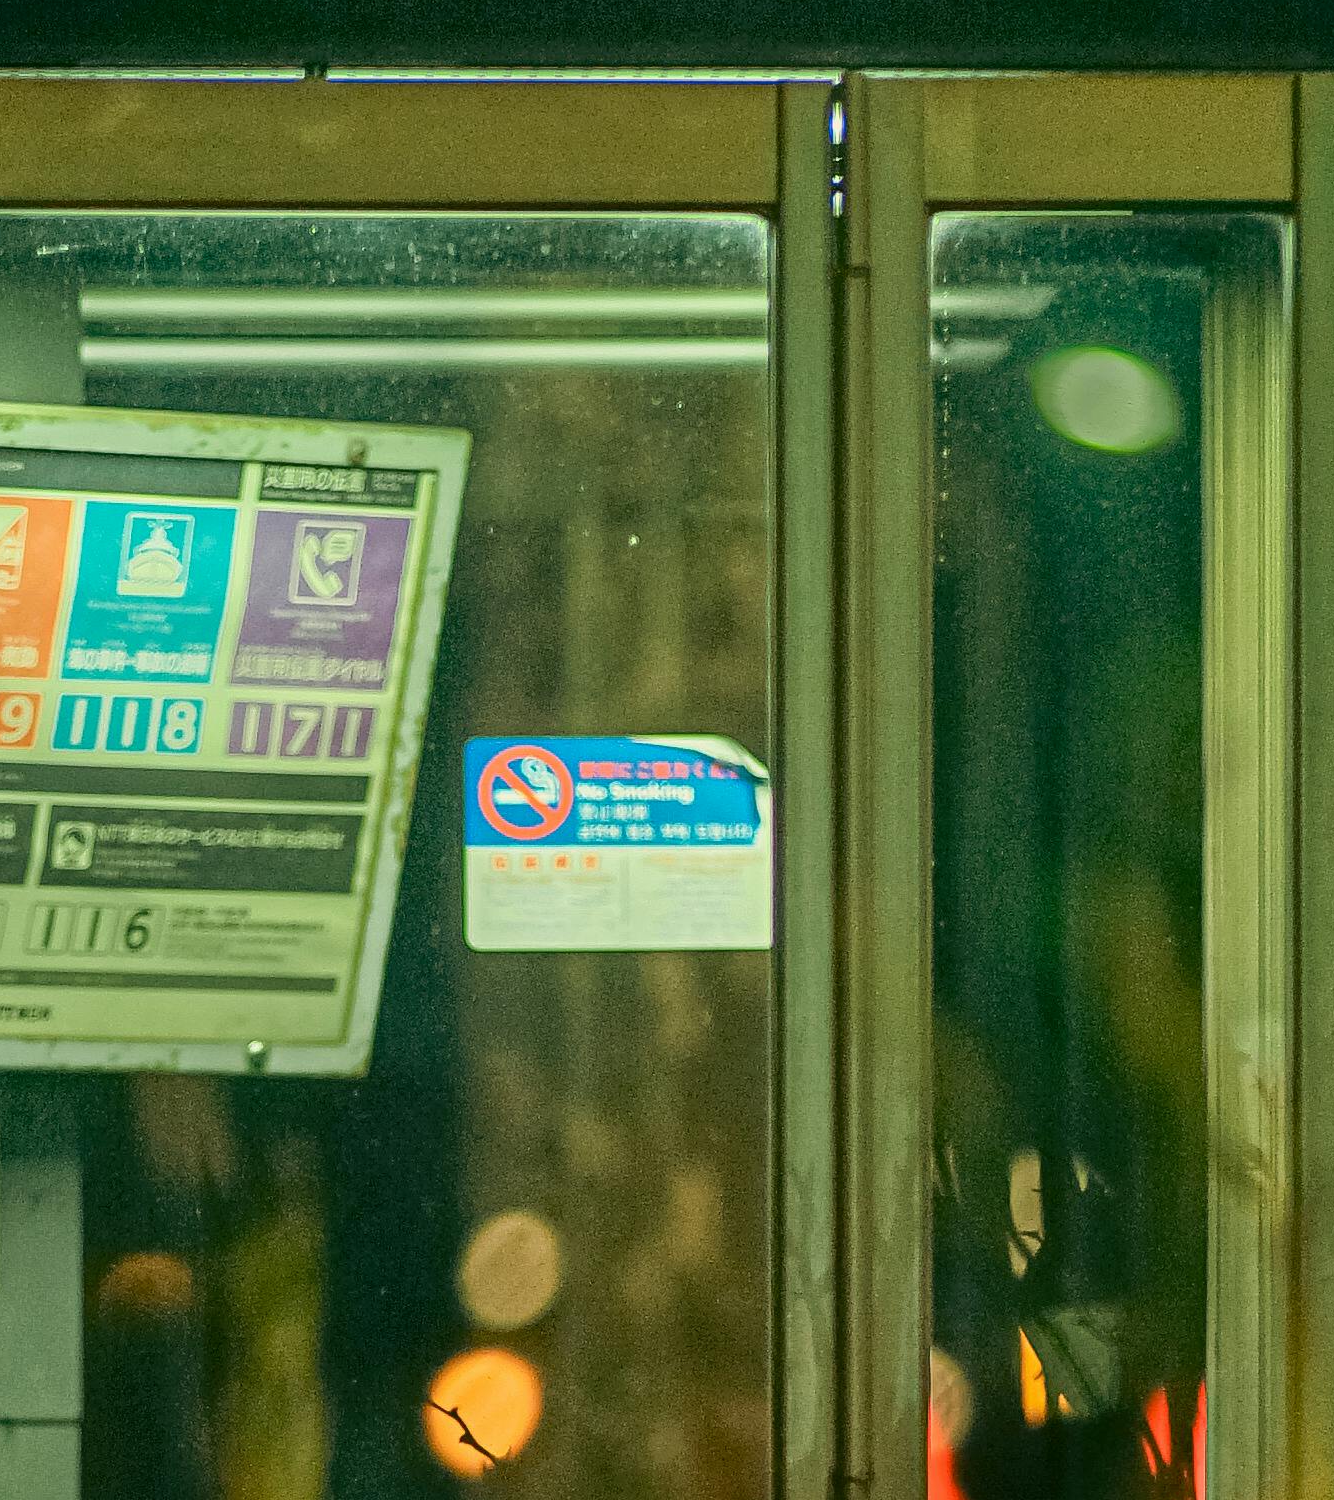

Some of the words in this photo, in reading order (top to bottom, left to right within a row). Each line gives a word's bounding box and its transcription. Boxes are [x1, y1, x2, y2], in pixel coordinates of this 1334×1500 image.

[69, 699, 198, 750] 118
[241, 703, 363, 756] 171
[577, 783, 608, 801] No
[609, 781, 695, 805] Smoking
[42, 908, 153, 951] 116
